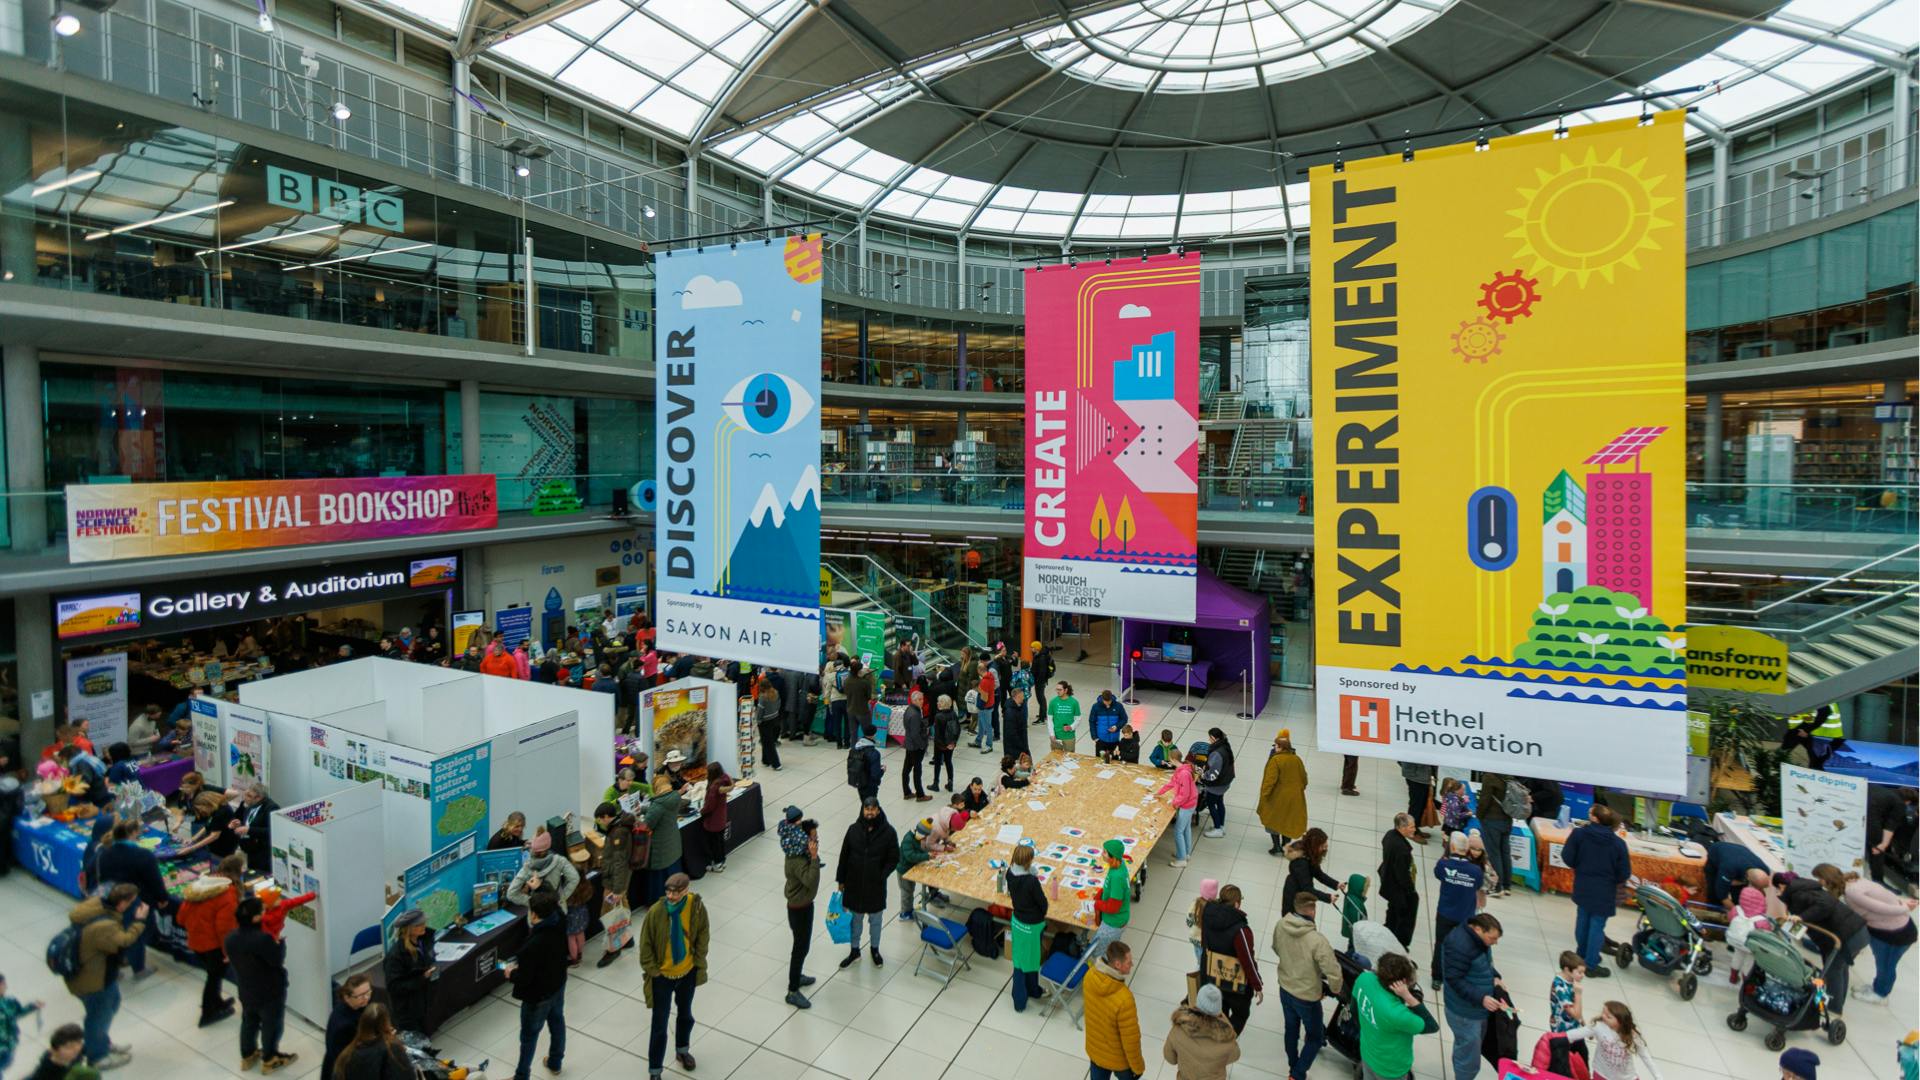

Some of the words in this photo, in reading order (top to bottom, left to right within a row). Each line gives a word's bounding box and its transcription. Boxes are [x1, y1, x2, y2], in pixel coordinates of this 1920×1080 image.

[277, 172, 401, 229] BBC
[1332, 180, 1401, 648] EXPERIMENT
[666, 325, 696, 579] DISCOVER
[1034, 390, 1067, 547] CREATE
[76, 507, 138, 519] NORWICH
[76, 516, 131, 528] SCIENCE
[158, 495, 311, 536] FESTIVAL
[319, 488, 454, 526] BOOKSHOP
[76, 525, 139, 537] FESTIVAL
[1066, 565, 1073, 573] by
[1038, 574, 1087, 587] NORWICH
[148, 589, 252, 617] Gallery
[259, 584, 278, 603] &
[284, 570, 404, 600] Auditorium
[1035, 593, 1048, 603] OF
[1050, 594, 1071, 606] THE
[1073, 596, 1101, 608] ARTS
[1045, 585, 1107, 598] UNIVERSITY
[666, 598, 693, 610] Sponsored
[693, 602, 703, 611] by
[666, 618, 731, 644] SAXON
[738, 627, 773, 648] AIR
[1686, 648, 1781, 667] ansform
[1688, 664, 1782, 681] morrow
[1338, 677, 1400, 692] Sponsored
[1402, 680, 1417, 695] by
[1395, 704, 1485, 730] Hethel
[1395, 724, 1544, 757] Innovation
[126, 761, 139, 773] TS
[434, 752, 475, 774] Explore
[434, 769, 457, 783] over
[459, 763, 472, 774] 40
[435, 774, 469, 793] nature
[1789, 770, 1816, 784] Pond
[1818, 774, 1858, 791] dipping
[435, 779, 478, 803] reserves
[31, 842, 59, 875] TSL
